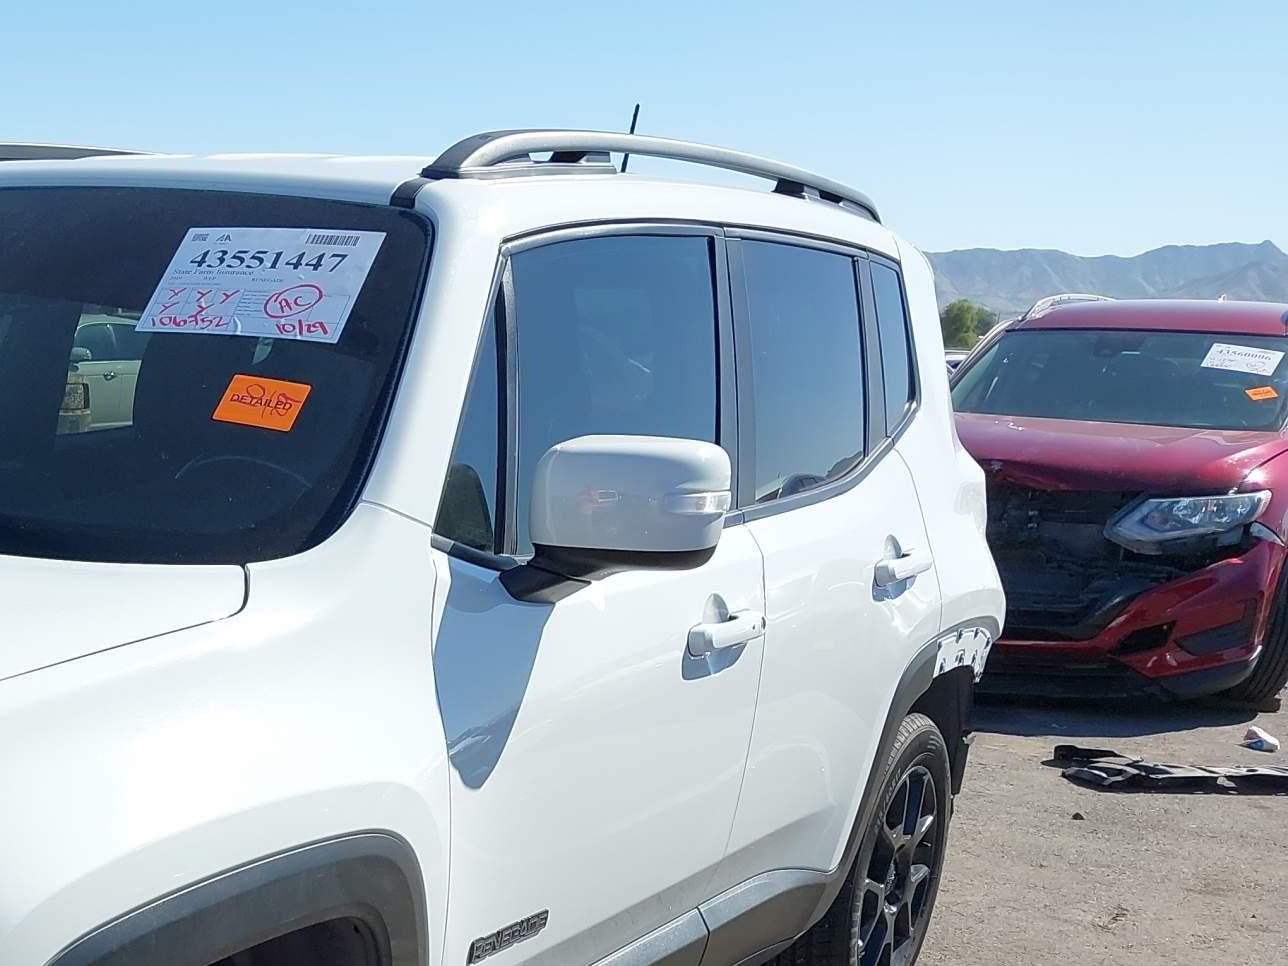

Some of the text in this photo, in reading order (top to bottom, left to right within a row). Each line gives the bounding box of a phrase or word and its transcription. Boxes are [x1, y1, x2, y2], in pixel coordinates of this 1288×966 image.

[189, 249, 349, 273] 43551447
[276, 319, 329, 336] 10/29
[230, 393, 293, 410] DETAILED
